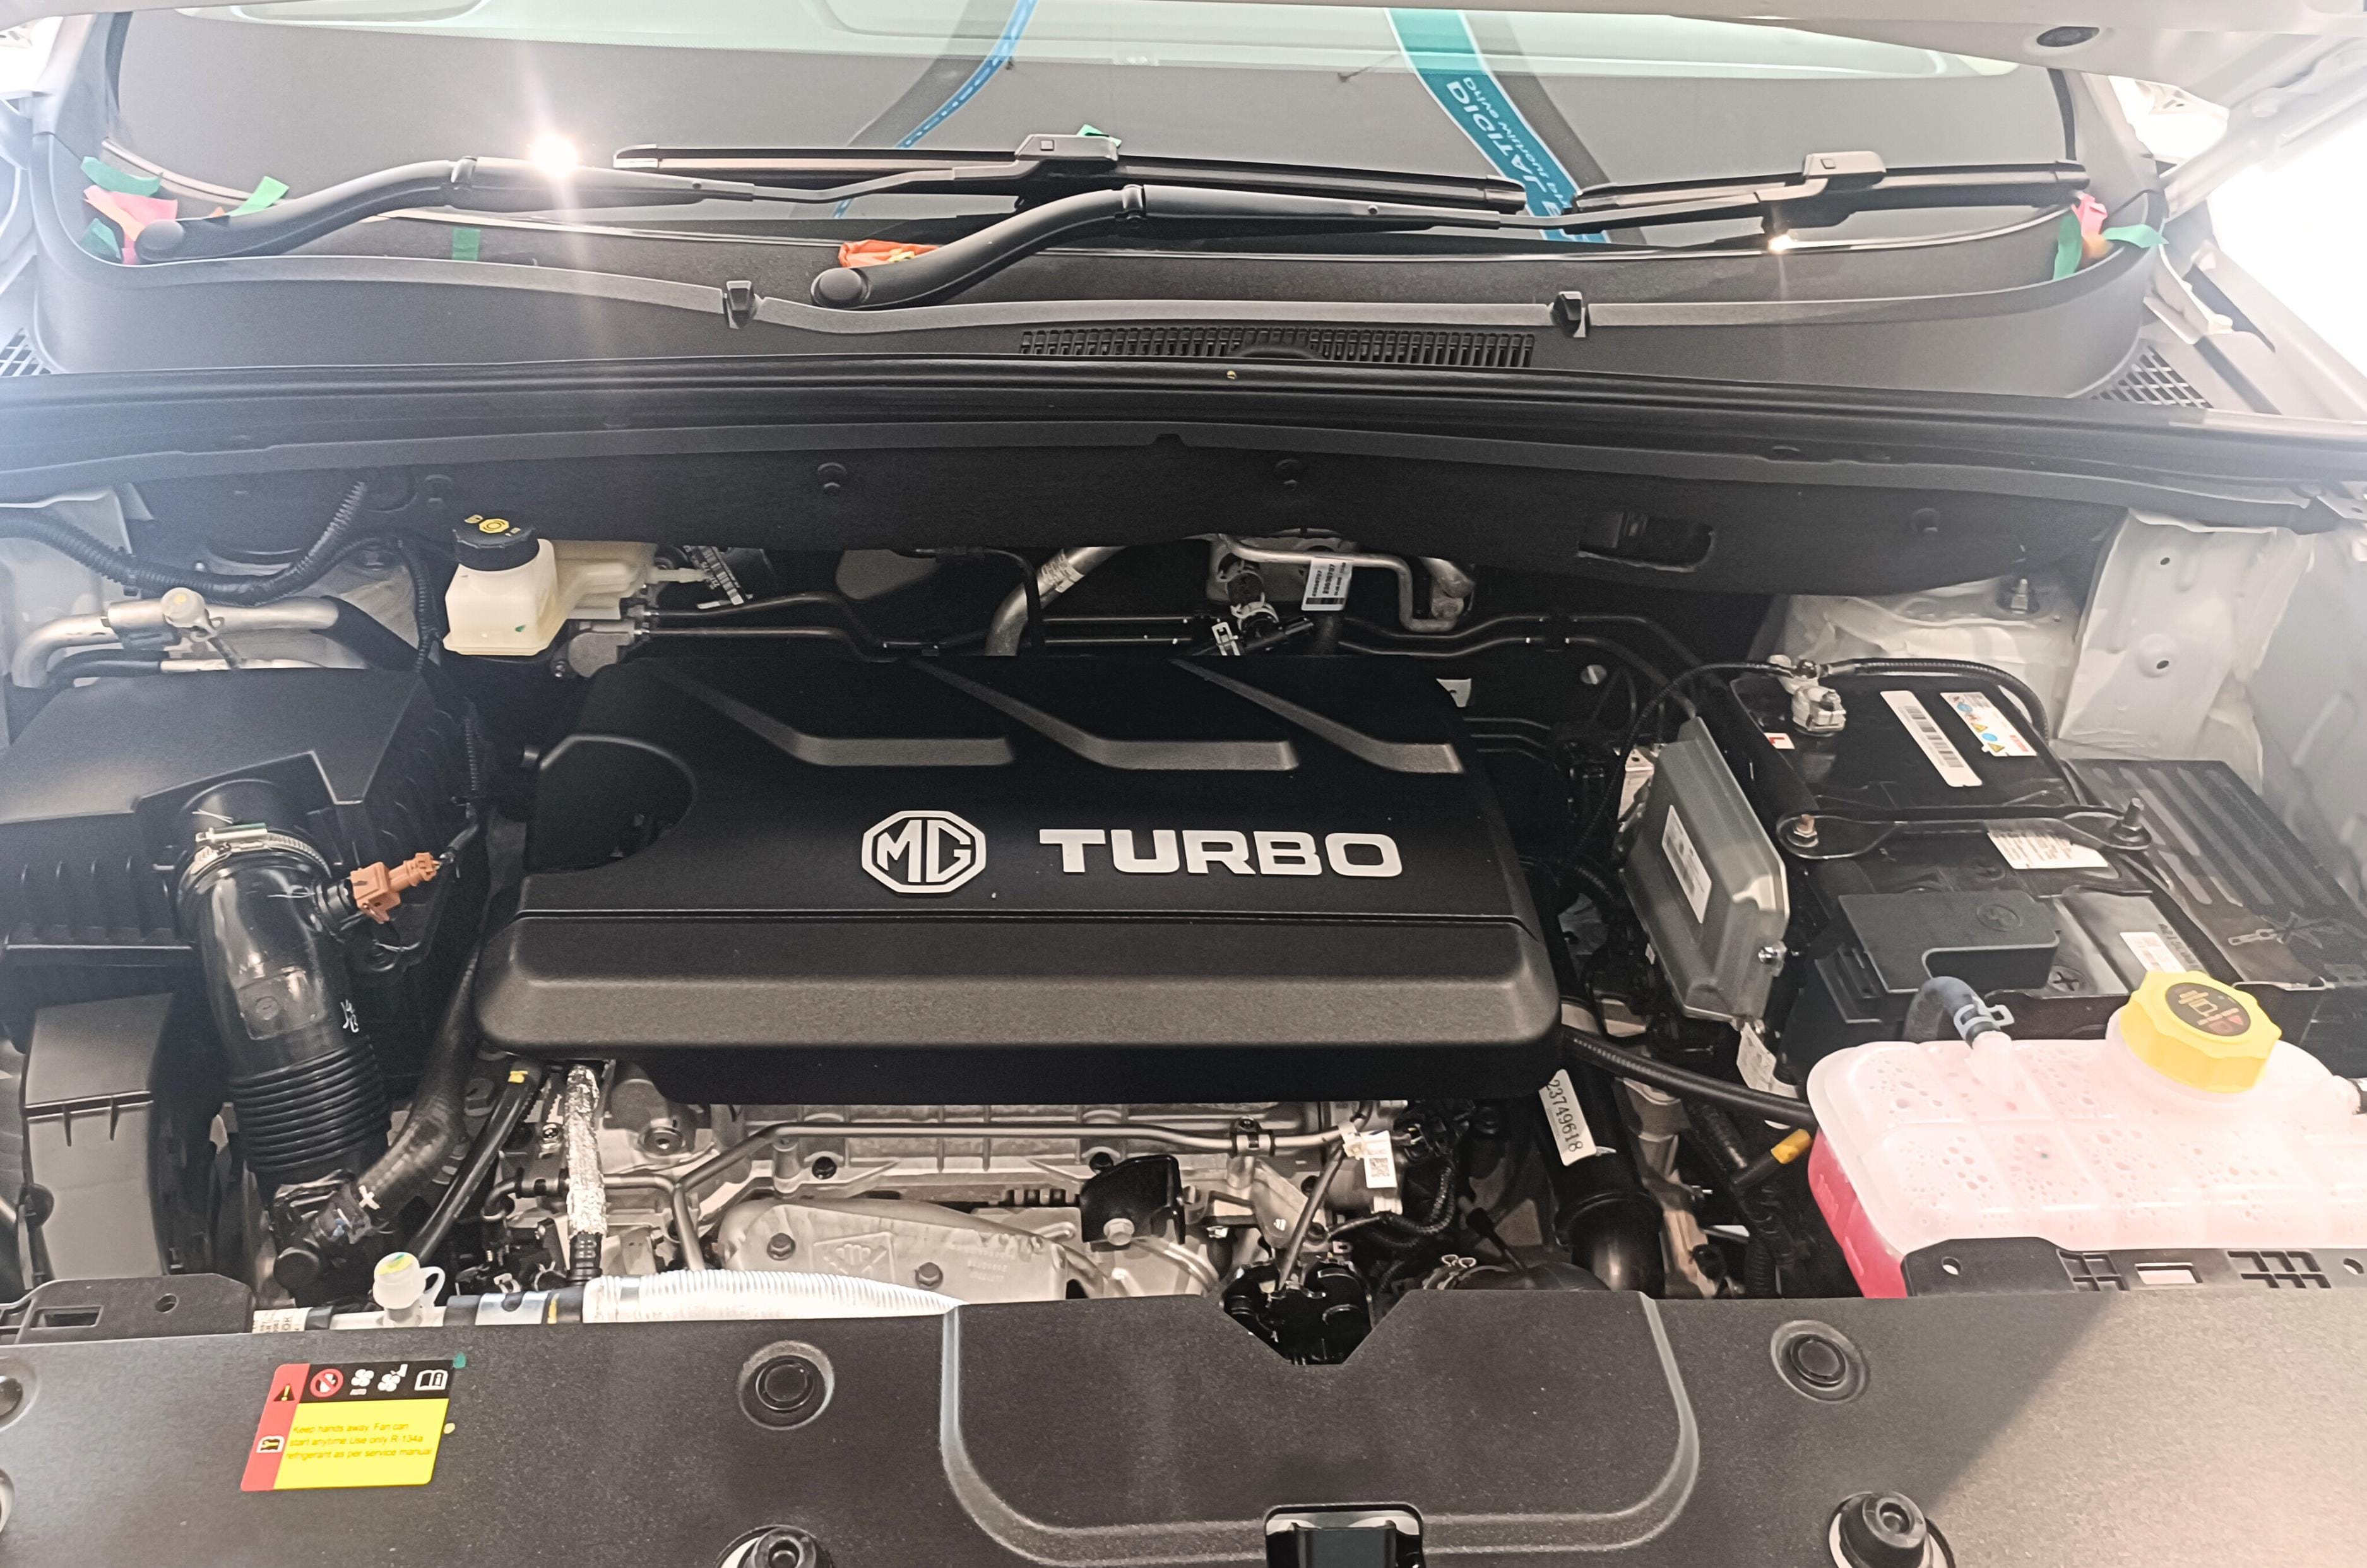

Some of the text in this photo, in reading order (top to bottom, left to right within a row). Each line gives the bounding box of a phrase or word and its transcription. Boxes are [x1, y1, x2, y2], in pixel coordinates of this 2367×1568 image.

[872, 816, 1403, 886] MG TURBO
[1546, 1079, 1583, 1153] 23749618
[374, 1423, 391, 1431] Fan
[369, 1436, 388, 1446] only
[347, 1451, 362, 1460] per
[365, 1449, 397, 1458] service
